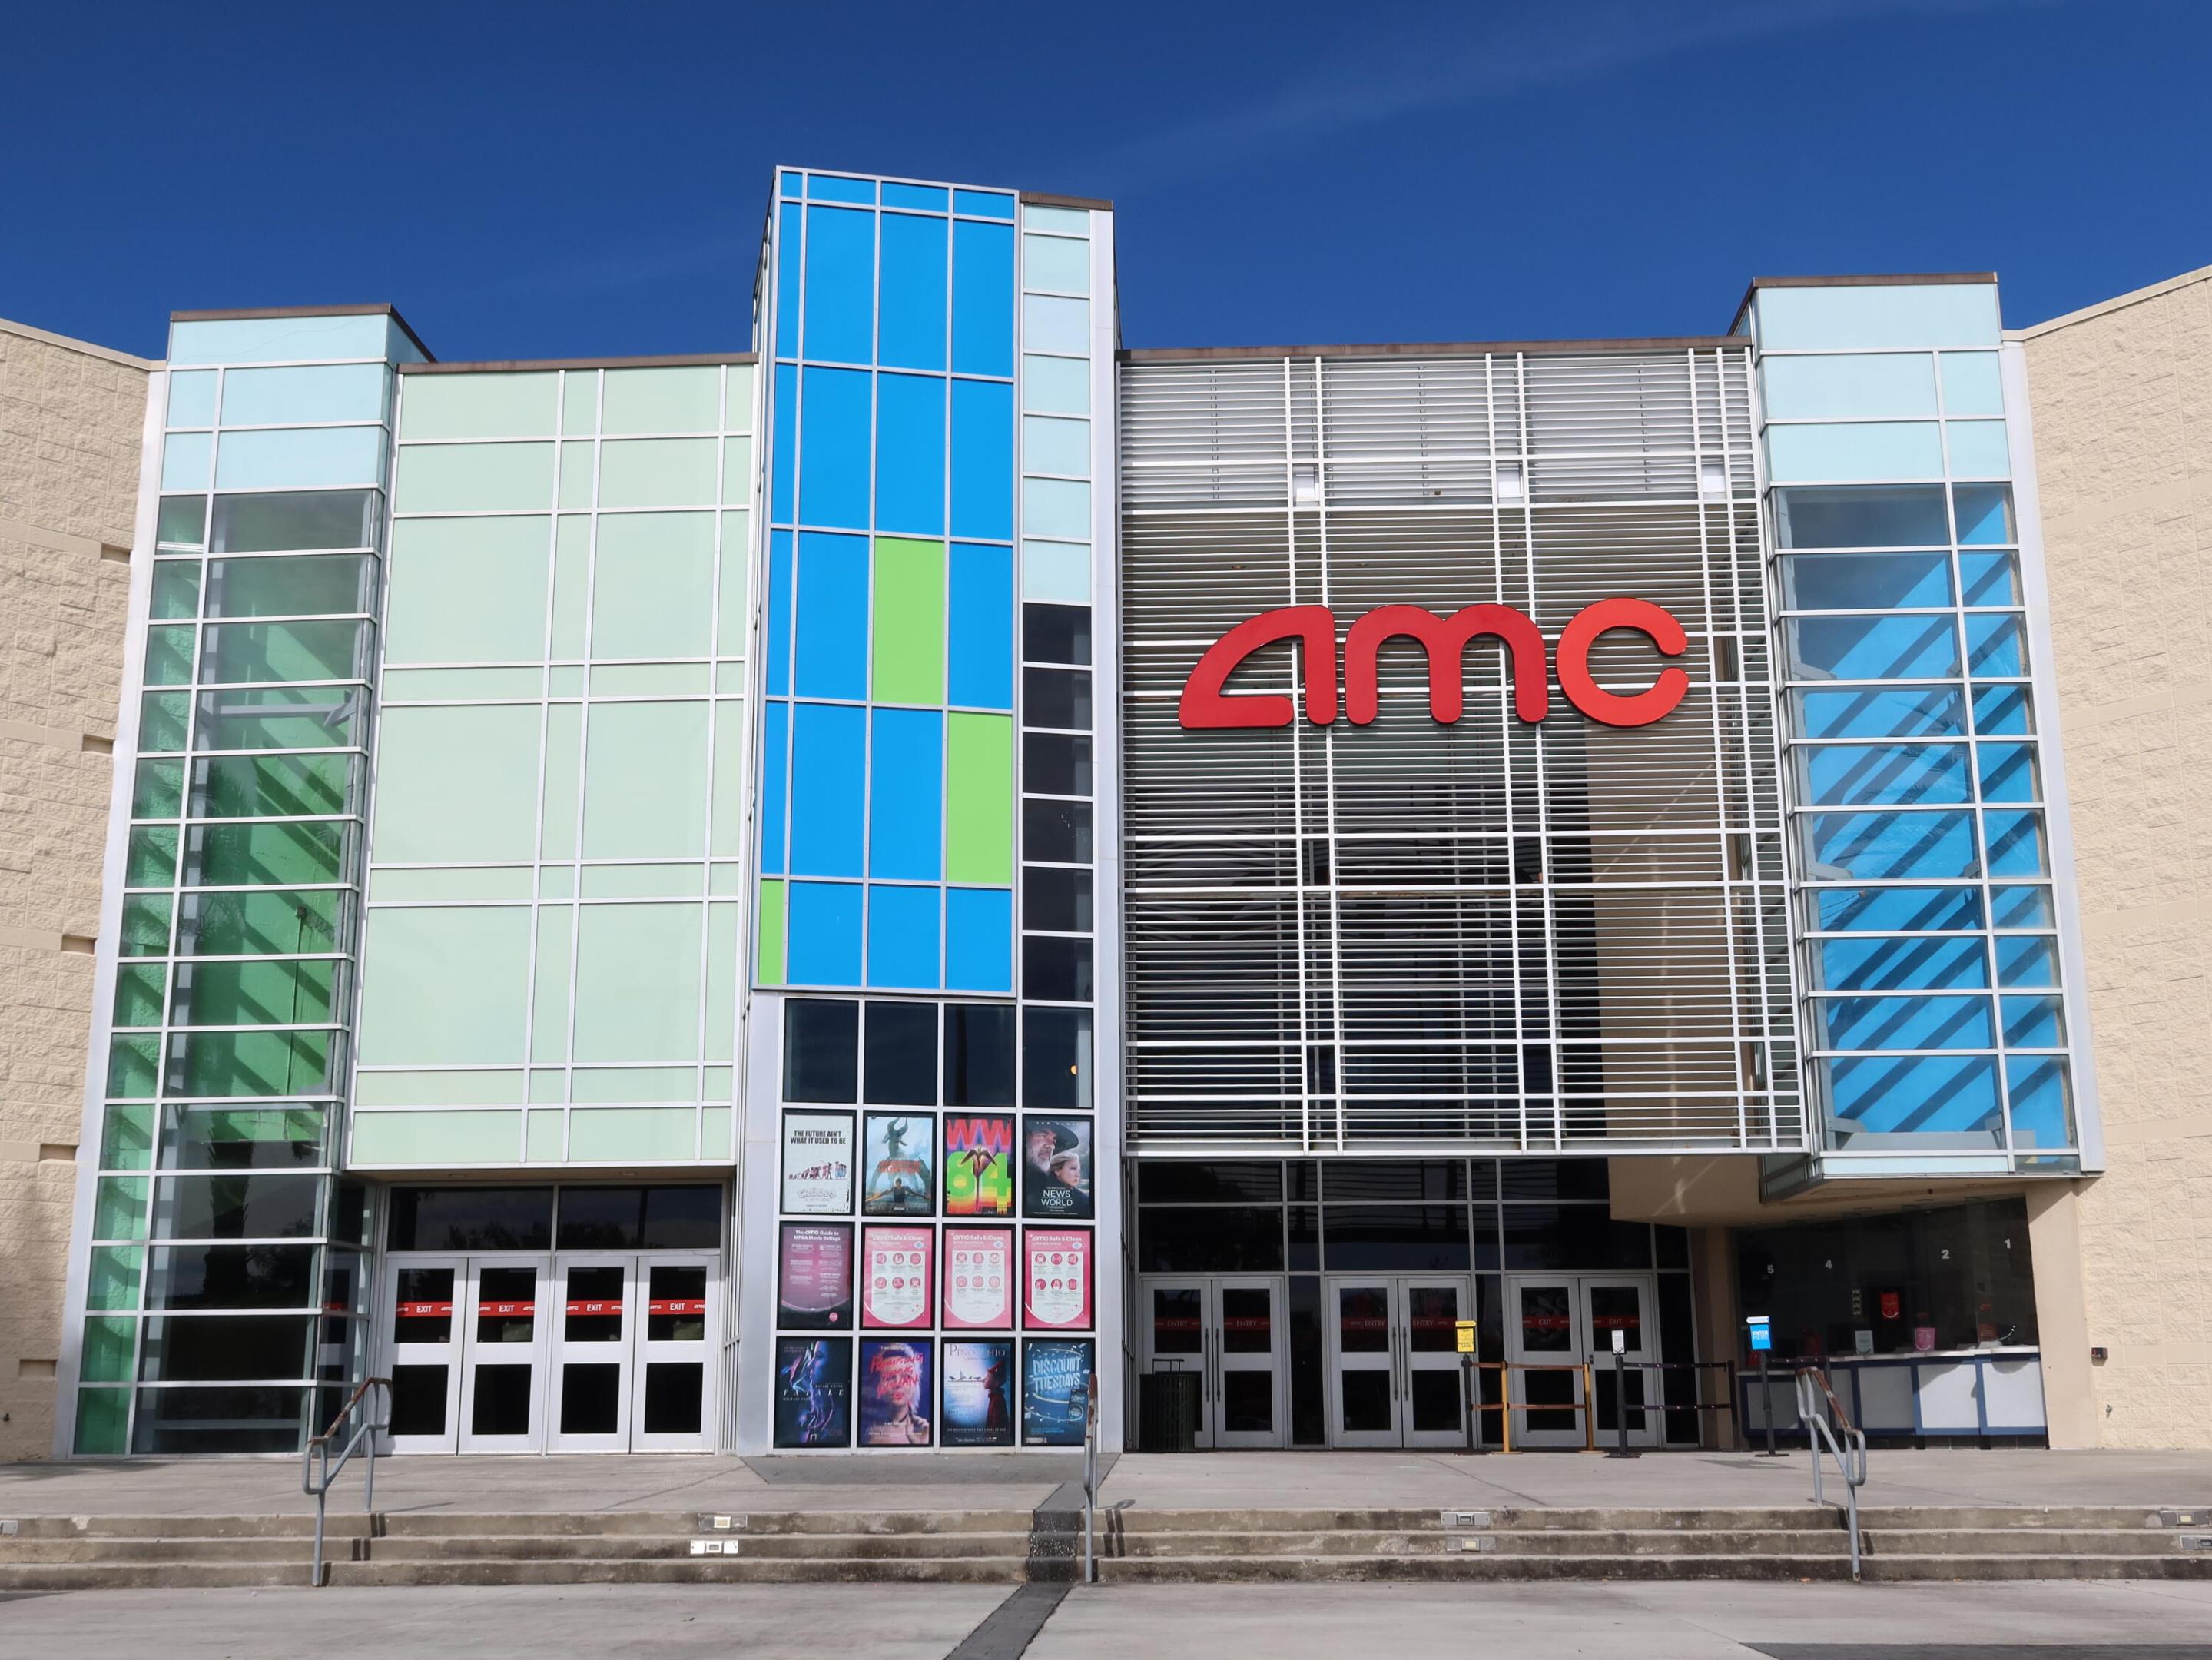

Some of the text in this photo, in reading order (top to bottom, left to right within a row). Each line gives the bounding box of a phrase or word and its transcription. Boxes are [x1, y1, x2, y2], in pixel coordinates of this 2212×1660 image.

[1178, 597, 1689, 729] amc
[1043, 1190, 1071, 1198] NEWS
[2004, 1238, 2011, 1249] 1
[1942, 1249, 1950, 1260] 2
[1767, 1264, 1774, 1273] 5
[1825, 1260, 1832, 1269] 4
[948, 1344, 1006, 1356] PINOHIO
[1033, 1356, 1082, 1376] DISCOUNT
[1033, 1373, 1081, 1394] TUESDAYS
